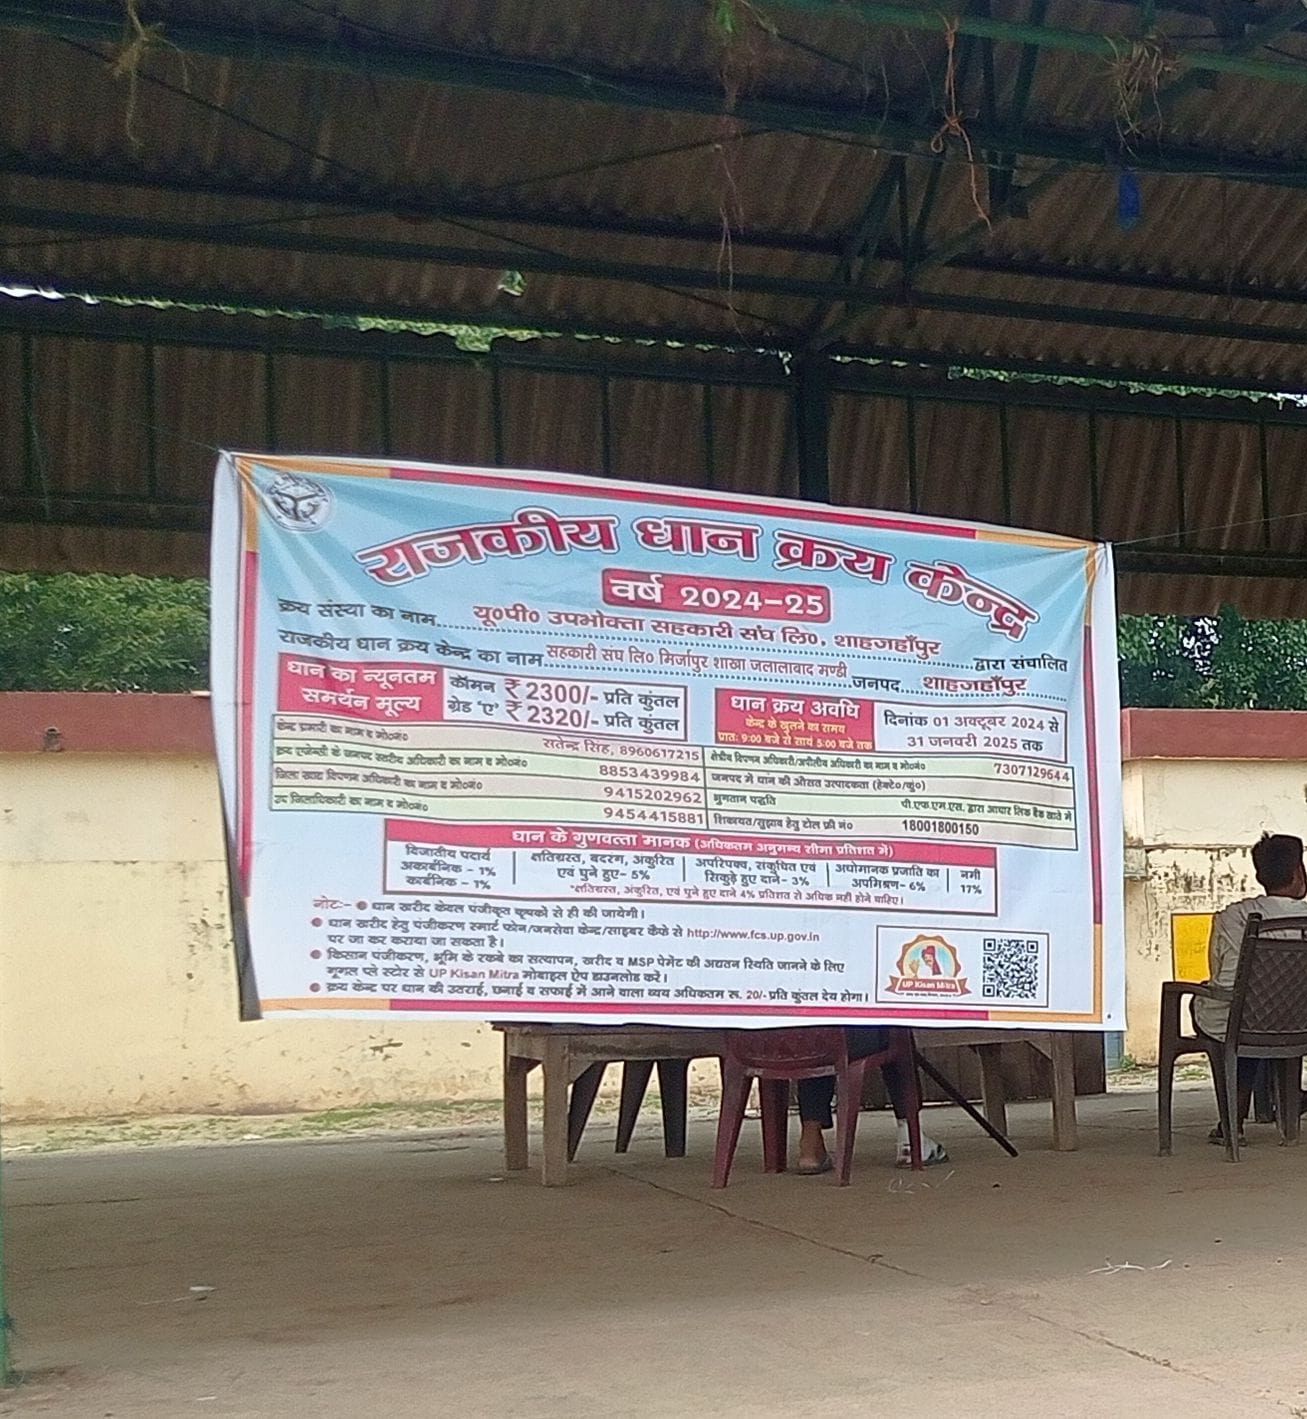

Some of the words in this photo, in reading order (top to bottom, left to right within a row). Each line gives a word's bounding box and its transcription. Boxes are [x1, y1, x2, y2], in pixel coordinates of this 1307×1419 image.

[356, 508, 619, 585] राजकीय
[633, 516, 761, 561] धान
[774, 529, 896, 584] क्रय
[904, 559, 1039, 641] केन्द्र
[610, 574, 663, 603] वर्ष
[680, 586, 824, 615] 2024-25
[279, 599, 311, 615] क्रय
[318, 600, 364, 620] संस्था
[371, 605, 395, 620] का
[549, 610, 643, 632] उपभोक्ता
[651, 620, 732, 640] सहकारी
[740, 624, 774, 642] संघ
[835, 635, 941, 659] शाहजहाँपुर
[279, 629, 350, 651] राजकीय
[357, 637, 390, 651] धान
[398, 640, 429, 654] क्रय
[436, 640, 471, 660] केन्द्र
[478, 649, 500, 664] का
[547, 643, 596, 661] सहकारी
[602, 646, 623, 662] संघ
[659, 649, 708, 672] मिर्जापुर
[714, 656, 746, 671] शाखा
[819, 661, 847, 679] मण्डी
[974, 657, 1005, 671] द्वारा
[1011, 654, 1068, 672] संचालित
[287, 661, 325, 680] धान
[332, 666, 356, 684] का
[363, 669, 437, 690] न्यूनतम
[923, 675, 1027, 697] शाहजहाँपुर
[449, 673, 496, 693] कॉमन
[604, 690, 632, 707] प्रति
[301, 687, 369, 709] समर्थन
[375, 695, 421, 717] मूल्य
[731, 695, 766, 712] धान
[772, 697, 804, 714] क्रय
[811, 699, 860, 718] अवधि
[604, 713, 633, 730] प्रति
[884, 710, 928, 727] दिनांक
[933, 716, 949, 728] 01
[1012, 717, 1044, 731] 2024
[1049, 716, 1059, 733] से
[619, 745, 700, 761] 8960617215
[907, 737, 924, 748] 31
[929, 734, 977, 749] जनवरी
[984, 737, 1018, 751] 2025
[1022, 739, 1043, 753] तक
[600, 765, 700, 783] 8853439984
[994, 762, 1070, 783] 7307129644
[604, 786, 701, 804] 9415202962
[603, 807, 704, 825] 9454415881
[902, 819, 979, 836] 18001800150
[512, 829, 545, 844] धान
[550, 827, 567, 844] के
[643, 835, 690, 850] मानक
[628, 957, 655, 968] MSP
[429, 968, 447, 979] UP
[450, 968, 486, 980] Kisan
[488, 970, 519, 981] Mitra
